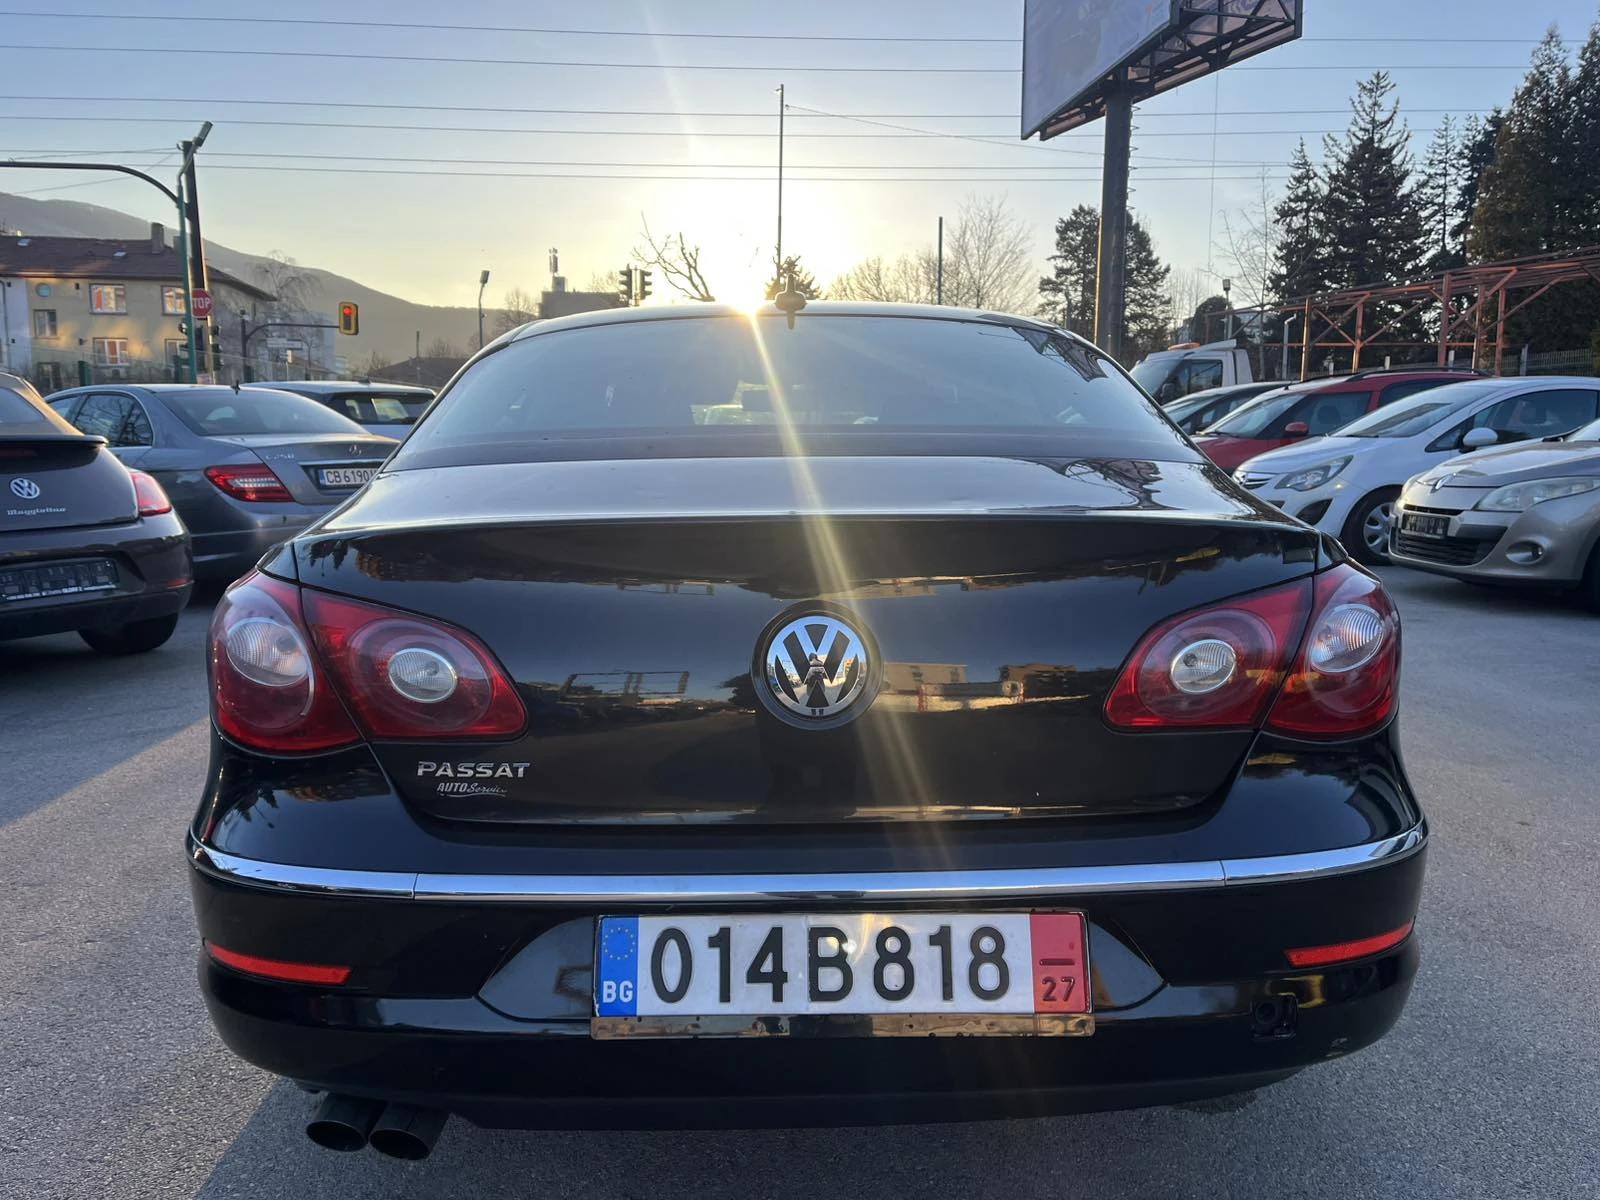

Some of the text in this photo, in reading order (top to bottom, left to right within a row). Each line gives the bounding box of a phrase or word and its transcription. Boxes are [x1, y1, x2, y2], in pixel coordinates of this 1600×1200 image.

[192, 297, 210, 309] TOP
[325, 470, 342, 484] CB
[766, 615, 867, 717] VW
[417, 761, 531, 778] PASSAT
[602, 981, 634, 1003] BG
[1041, 975, 1076, 1002] 27
